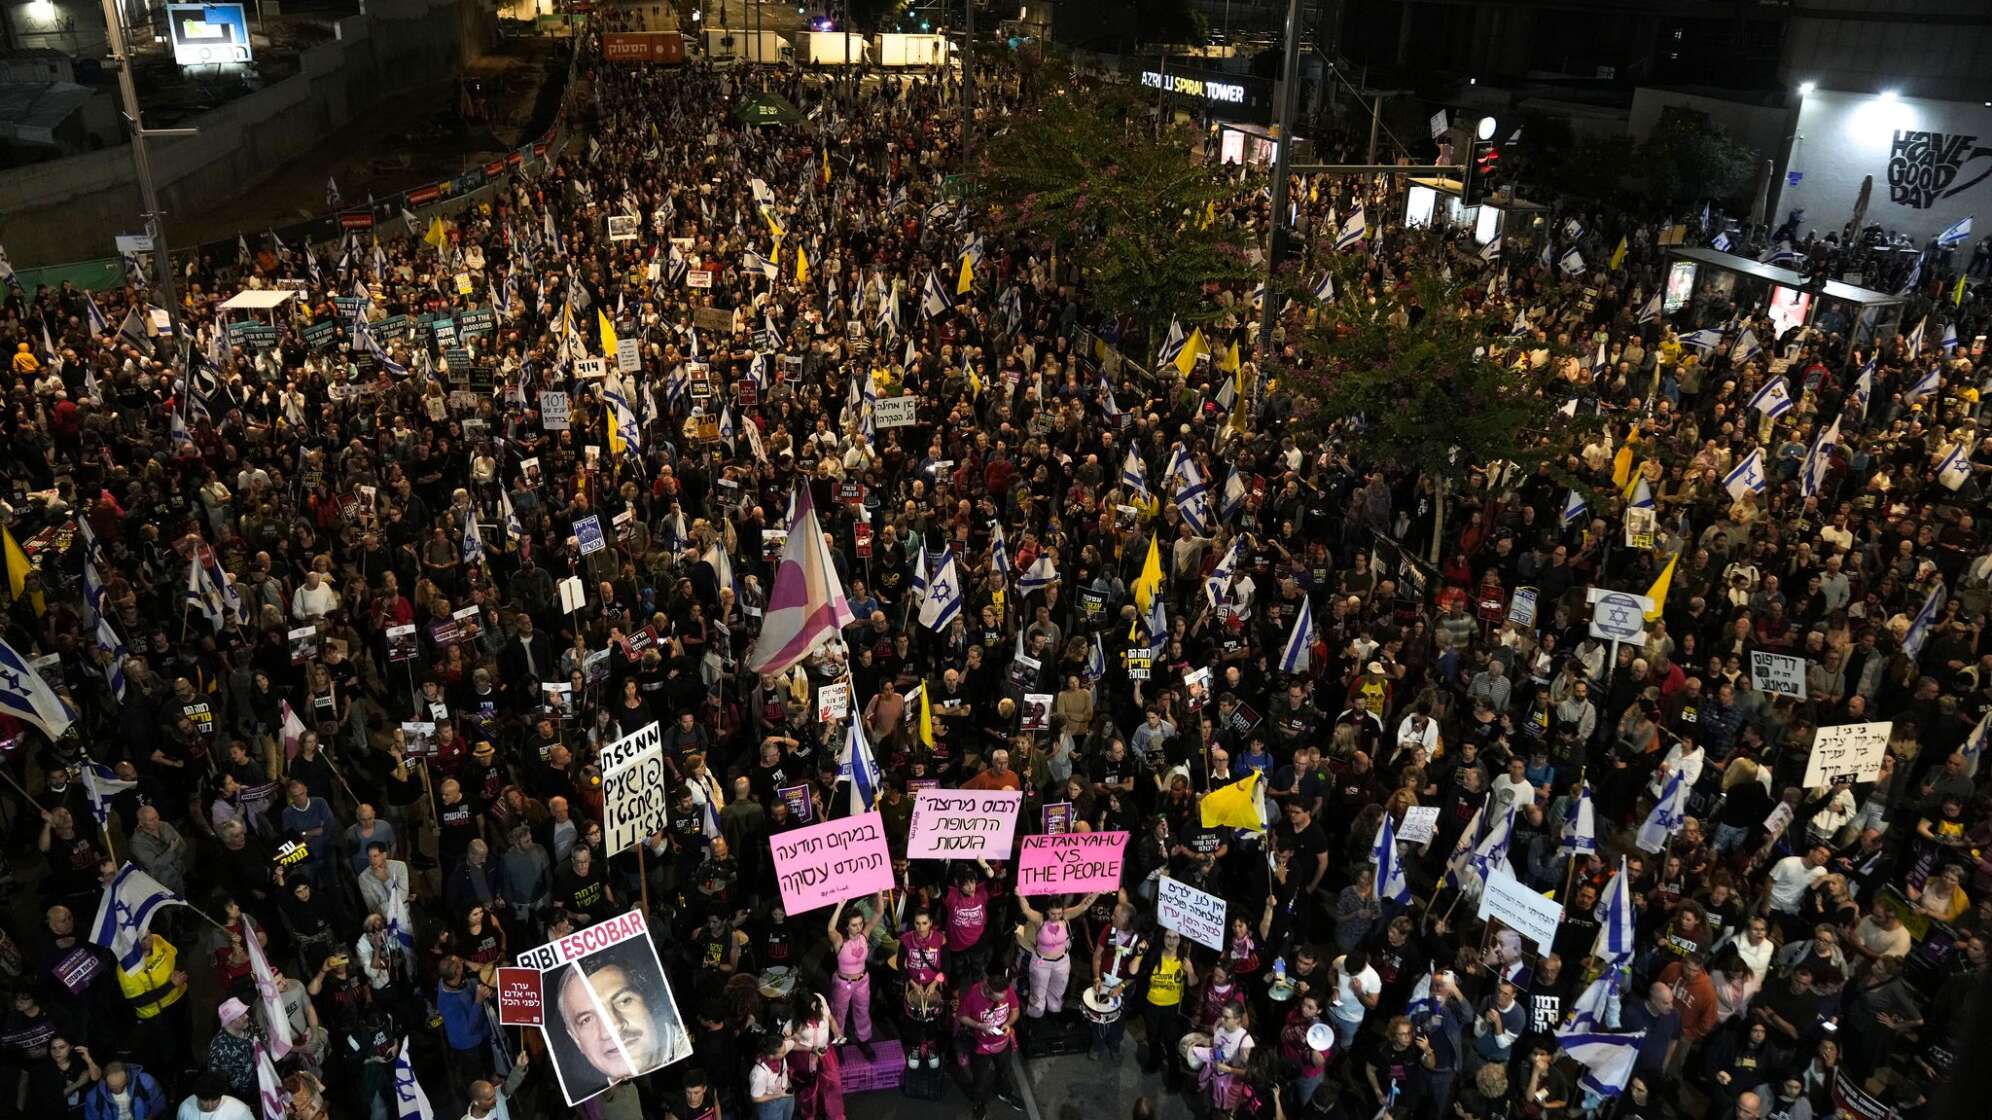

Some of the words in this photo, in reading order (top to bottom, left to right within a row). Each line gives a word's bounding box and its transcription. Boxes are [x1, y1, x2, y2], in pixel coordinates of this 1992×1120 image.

[1205, 81, 1244, 103] TOWER
[1888, 157, 1958, 191] GOOD
[1890, 185, 1943, 209] DAY
[578, 361, 599, 372] 414
[543, 394, 566, 407] 101
[826, 825, 880, 850] במקום
[1023, 835, 1125, 849] NETANYAHU
[776, 837, 823, 861] תודעה
[834, 853, 883, 875] תהנדס
[1021, 866, 1058, 884] THE
[1063, 861, 1120, 881] PEOPLE
[781, 862, 829, 895] עסקה
[520, 944, 560, 970] BIBI
[559, 912, 645, 961] ESCOBAR
[504, 990, 524, 998] אדם
[511, 983, 529, 991] ערך
[1535, 995, 1560, 1010] דמו
